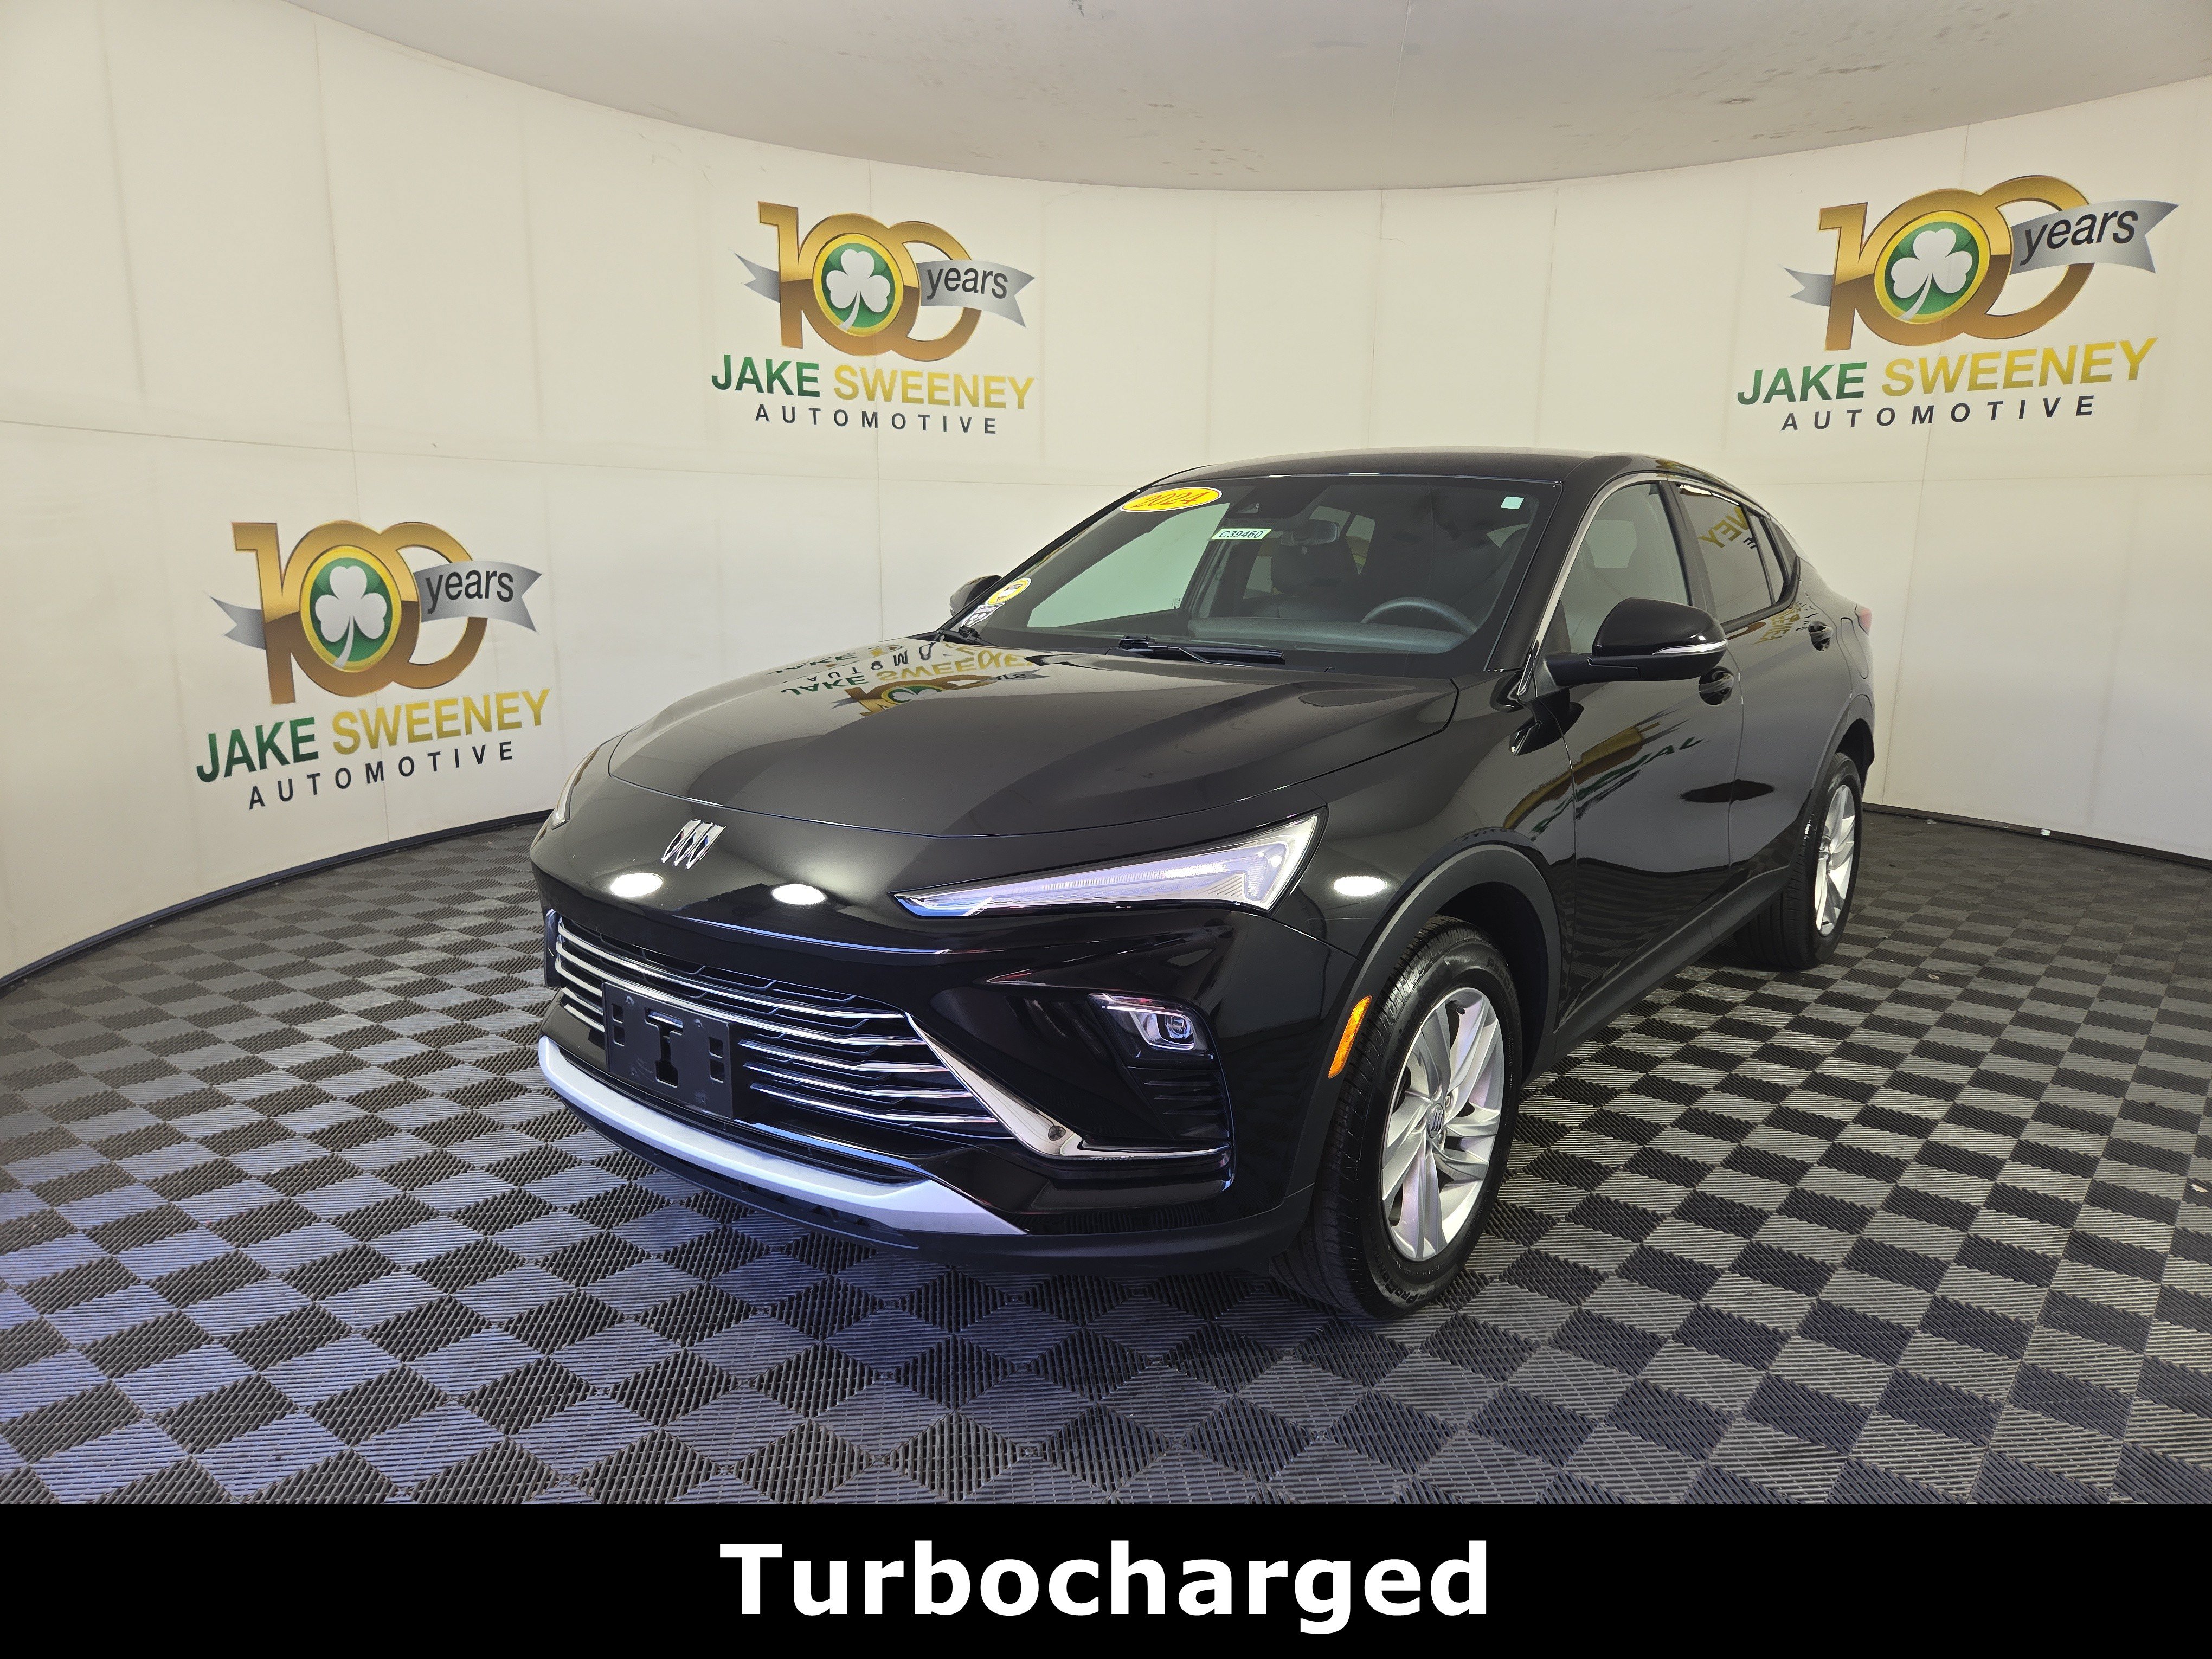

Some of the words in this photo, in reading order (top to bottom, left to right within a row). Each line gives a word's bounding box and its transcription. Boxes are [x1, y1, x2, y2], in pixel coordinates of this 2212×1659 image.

[758, 201, 982, 362] 100
[926, 265, 1009, 300] years
[1818, 175, 2095, 351] 100
[2020, 210, 2138, 265] years
[711, 354, 821, 398] JAKE
[833, 364, 1035, 409] SWEENEY
[1737, 361, 1867, 406] JAKE
[1881, 337, 2158, 397] SWEENEY
[755, 403, 997, 435] AUTOMOTIVE
[1780, 395, 2095, 433] AUTOMOTIVE
[1129, 491, 1211, 509] 2024
[1219, 530, 1264, 538] C39460
[231, 520, 488, 705] 100
[425, 569, 515, 615] years
[196, 717, 319, 783] JAKE
[332, 688, 551, 755] SWEENEY
[248, 741, 513, 810] AUTOMOTIVE
